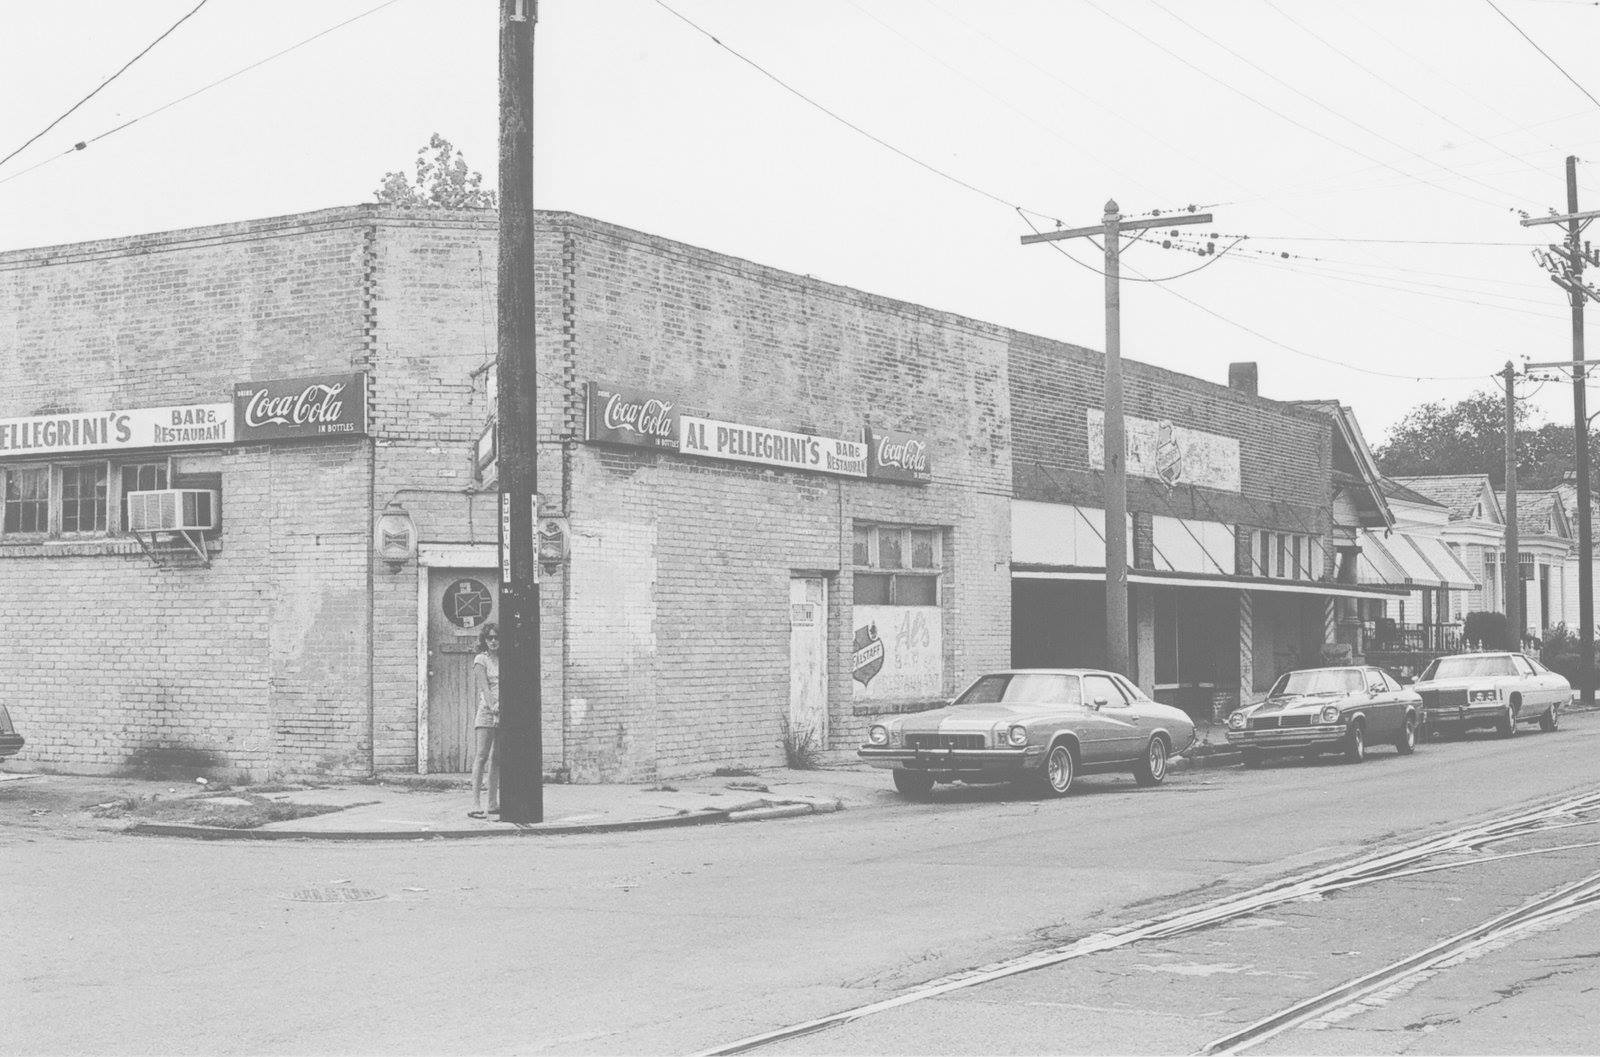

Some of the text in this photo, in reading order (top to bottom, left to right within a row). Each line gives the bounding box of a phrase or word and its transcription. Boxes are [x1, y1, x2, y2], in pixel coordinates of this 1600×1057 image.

[0, 412, 131, 450] ELLEGRINI'S
[154, 419, 227, 443] RESTAURANT
[318, 423, 354, 433] IN BOTTLES
[686, 422, 820, 465] AL PELLEGRINI'S
